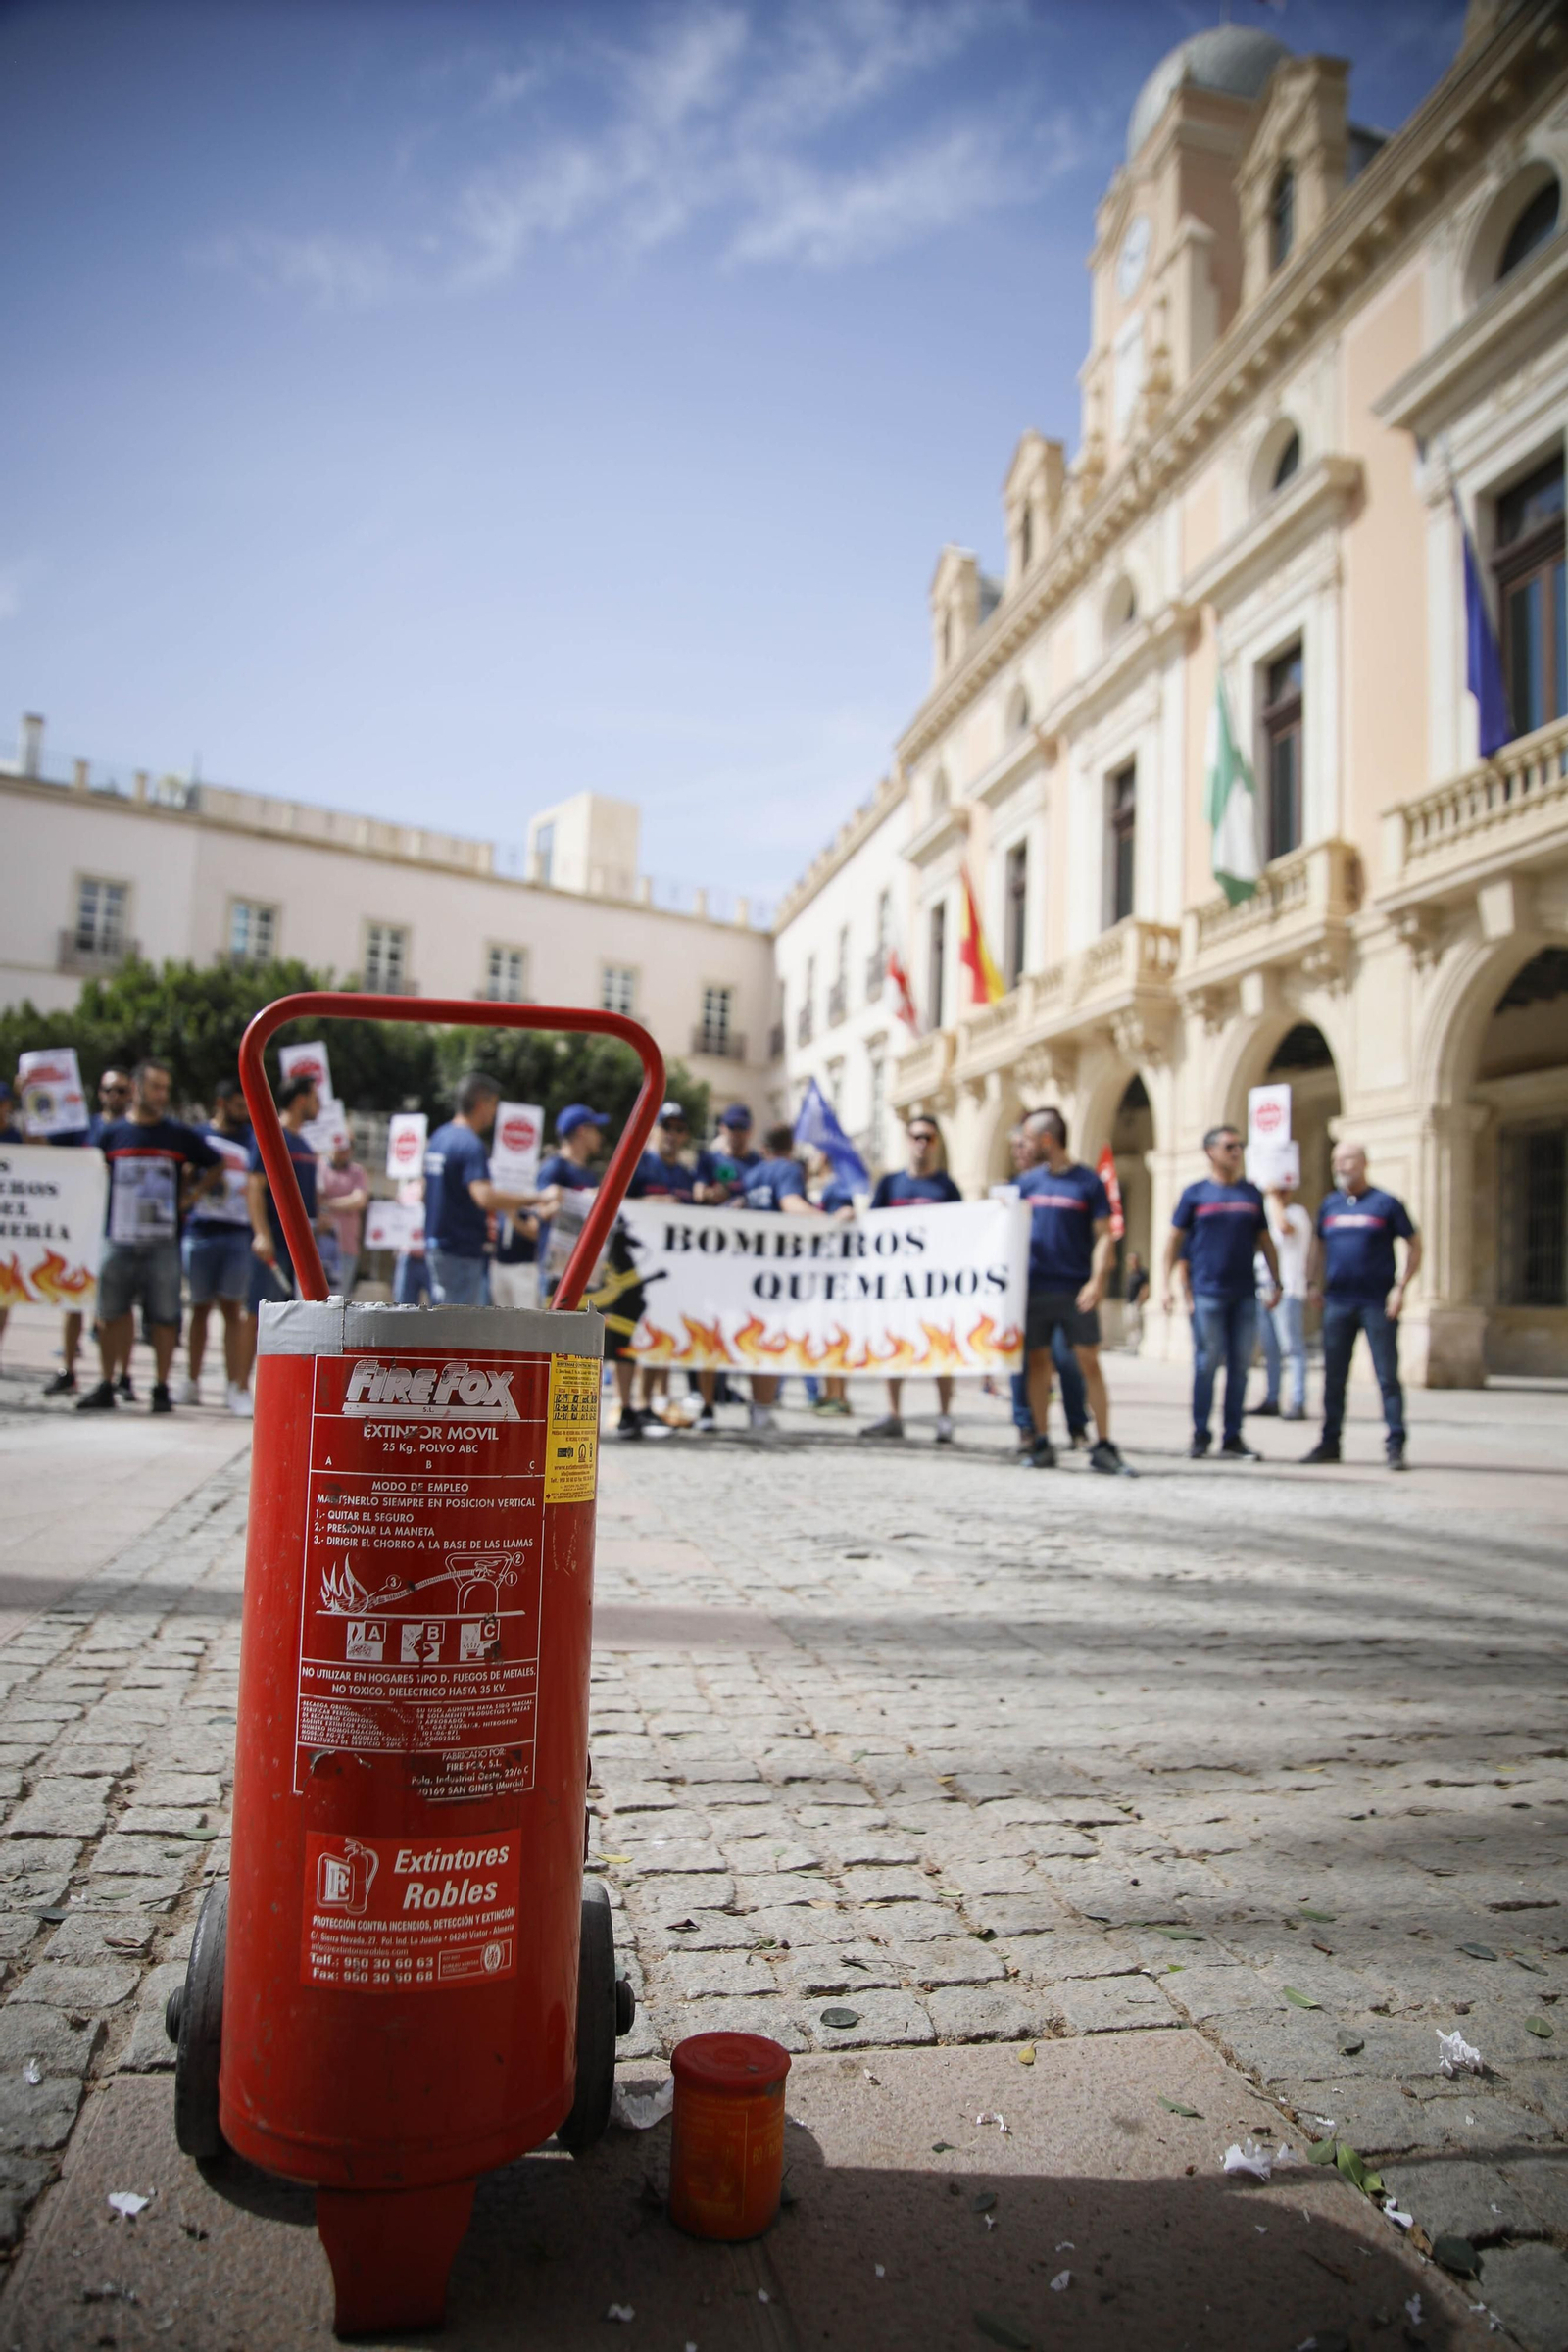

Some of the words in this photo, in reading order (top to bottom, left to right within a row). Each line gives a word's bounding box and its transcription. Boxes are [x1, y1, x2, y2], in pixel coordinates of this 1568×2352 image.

[663, 1224, 926, 1258] BOMBEROS
[753, 1264, 1008, 1300] QUEMADOS
[447, 1426, 499, 1441] MOVIL
[382, 1443, 395, 1451] 25
[399, 1443, 416, 1454] Kg.
[419, 1444, 455, 1453] POLVO
[459, 1444, 479, 1453] ABC
[325, 1456, 332, 1465] A
[425, 1460, 432, 1469] B
[529, 1460, 535, 1469] C
[372, 1481, 407, 1492] MODO
[411, 1482, 423, 1492] DE
[427, 1483, 469, 1492] EMPLEO
[382, 1497, 424, 1507] SIEMPRE
[428, 1498, 442, 1507] EN
[446, 1498, 494, 1508] POSICION
[498, 1498, 536, 1507] VERTICAL
[328, 1510, 359, 1521] QUITAR
[362, 1512, 371, 1521] EL
[375, 1512, 415, 1522] SEGURO
[380, 1526, 392, 1535] LA
[394, 1527, 435, 1537] MANETA
[326, 1536, 358, 1546] DIRIGIR
[362, 1539, 370, 1547] EL
[373, 1539, 415, 1548] CHORRO
[417, 1540, 425, 1548] A
[428, 1540, 440, 1549] LA
[444, 1540, 467, 1549] BASE
[470, 1540, 481, 1548] DE
[484, 1540, 500, 1548] LAS
[503, 1539, 533, 1548] LLAMAS
[389, 1577, 397, 1587] 3
[368, 1625, 380, 1640] A
[427, 1625, 439, 1640] B
[484, 1623, 496, 1638] C
[302, 1666, 315, 1677] NO
[317, 1668, 351, 1681] UTILIZAR
[354, 1672, 366, 1682] EN
[368, 1673, 414, 1684] HOGARES
[440, 1674, 450, 1683] D.
[453, 1672, 488, 1683] FUEGOS
[490, 1670, 500, 1680] DE
[503, 1666, 536, 1679] METALES.
[332, 1684, 346, 1694] NO
[389, 1687, 446, 1697] DIELECTRICO
[449, 1686, 477, 1695] HASTA
[480, 1685, 491, 1694] 35
[493, 1683, 506, 1693] KV.
[442, 1750, 488, 1761] FABRICADO
[489, 1759, 502, 1768] S.L.
[436, 1773, 475, 1783] Industrial
[448, 1785, 466, 1794] SAN
[496, 1778, 524, 1790] (Murcia)
[393, 1845, 510, 1874] Extintores
[402, 1879, 499, 1910] Robles
[313, 1915, 356, 1931] PROTECCIÓN
[358, 1920, 387, 1932] CONTRA
[389, 1920, 431, 1932] INCENDIOS,
[433, 1914, 473, 1929] DETECCIÓN
[475, 1915, 480, 1924] Y
[481, 1906, 515, 1924] EXTINCIÓN
[320, 1932, 339, 1942] Sierra
[449, 1932, 468, 1941] 04240
[470, 1930, 488, 1939] Viator
[344, 1956, 368, 1968] 950
[373, 1957, 390, 1969] 30
[395, 1957, 412, 1969] 60
[416, 1956, 433, 1968] 63
[313, 1967, 339, 1980] Fax:
[373, 1972, 390, 1984] 30
[416, 1971, 433, 1983] 68
